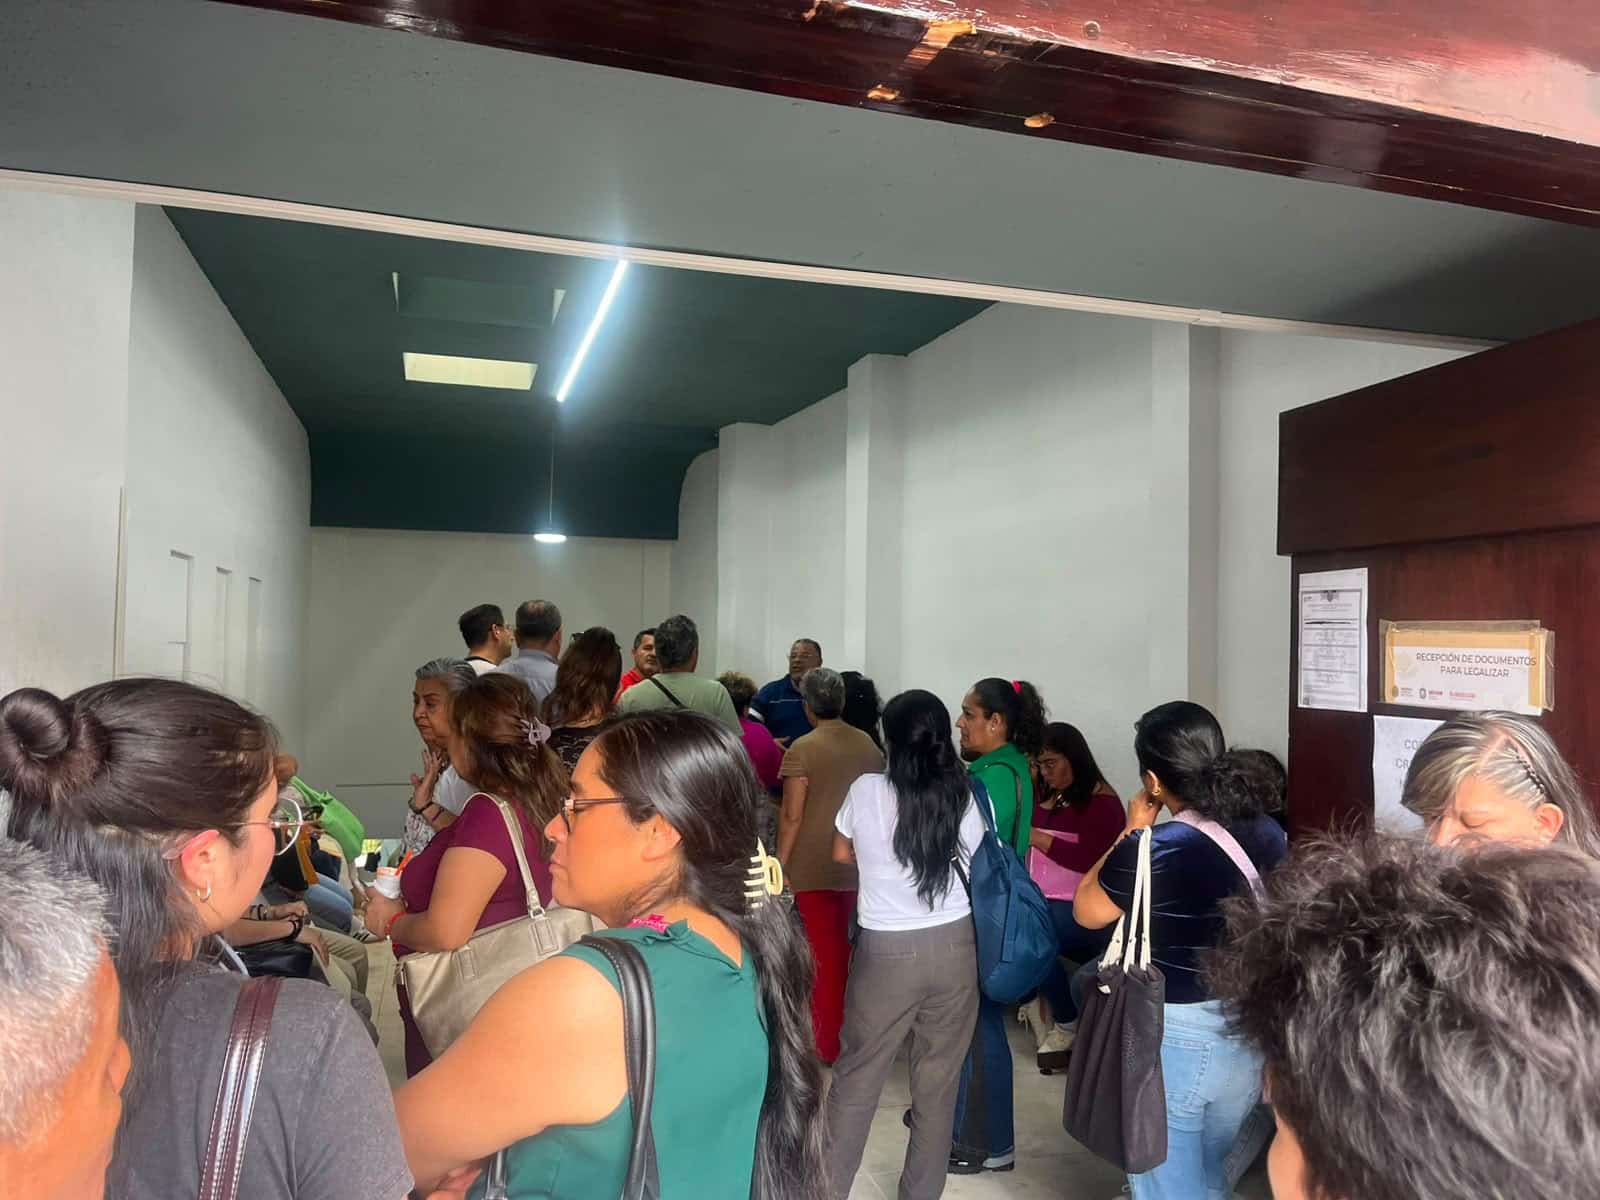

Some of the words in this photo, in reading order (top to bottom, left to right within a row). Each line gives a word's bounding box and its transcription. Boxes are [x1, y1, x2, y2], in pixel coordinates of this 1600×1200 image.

[1462, 654, 1473, 664] DE
[1474, 655, 1537, 666] DOCUMENTOS
[1440, 665, 1462, 675] PARA
[1463, 666, 1510, 677] LEGALIZAR
